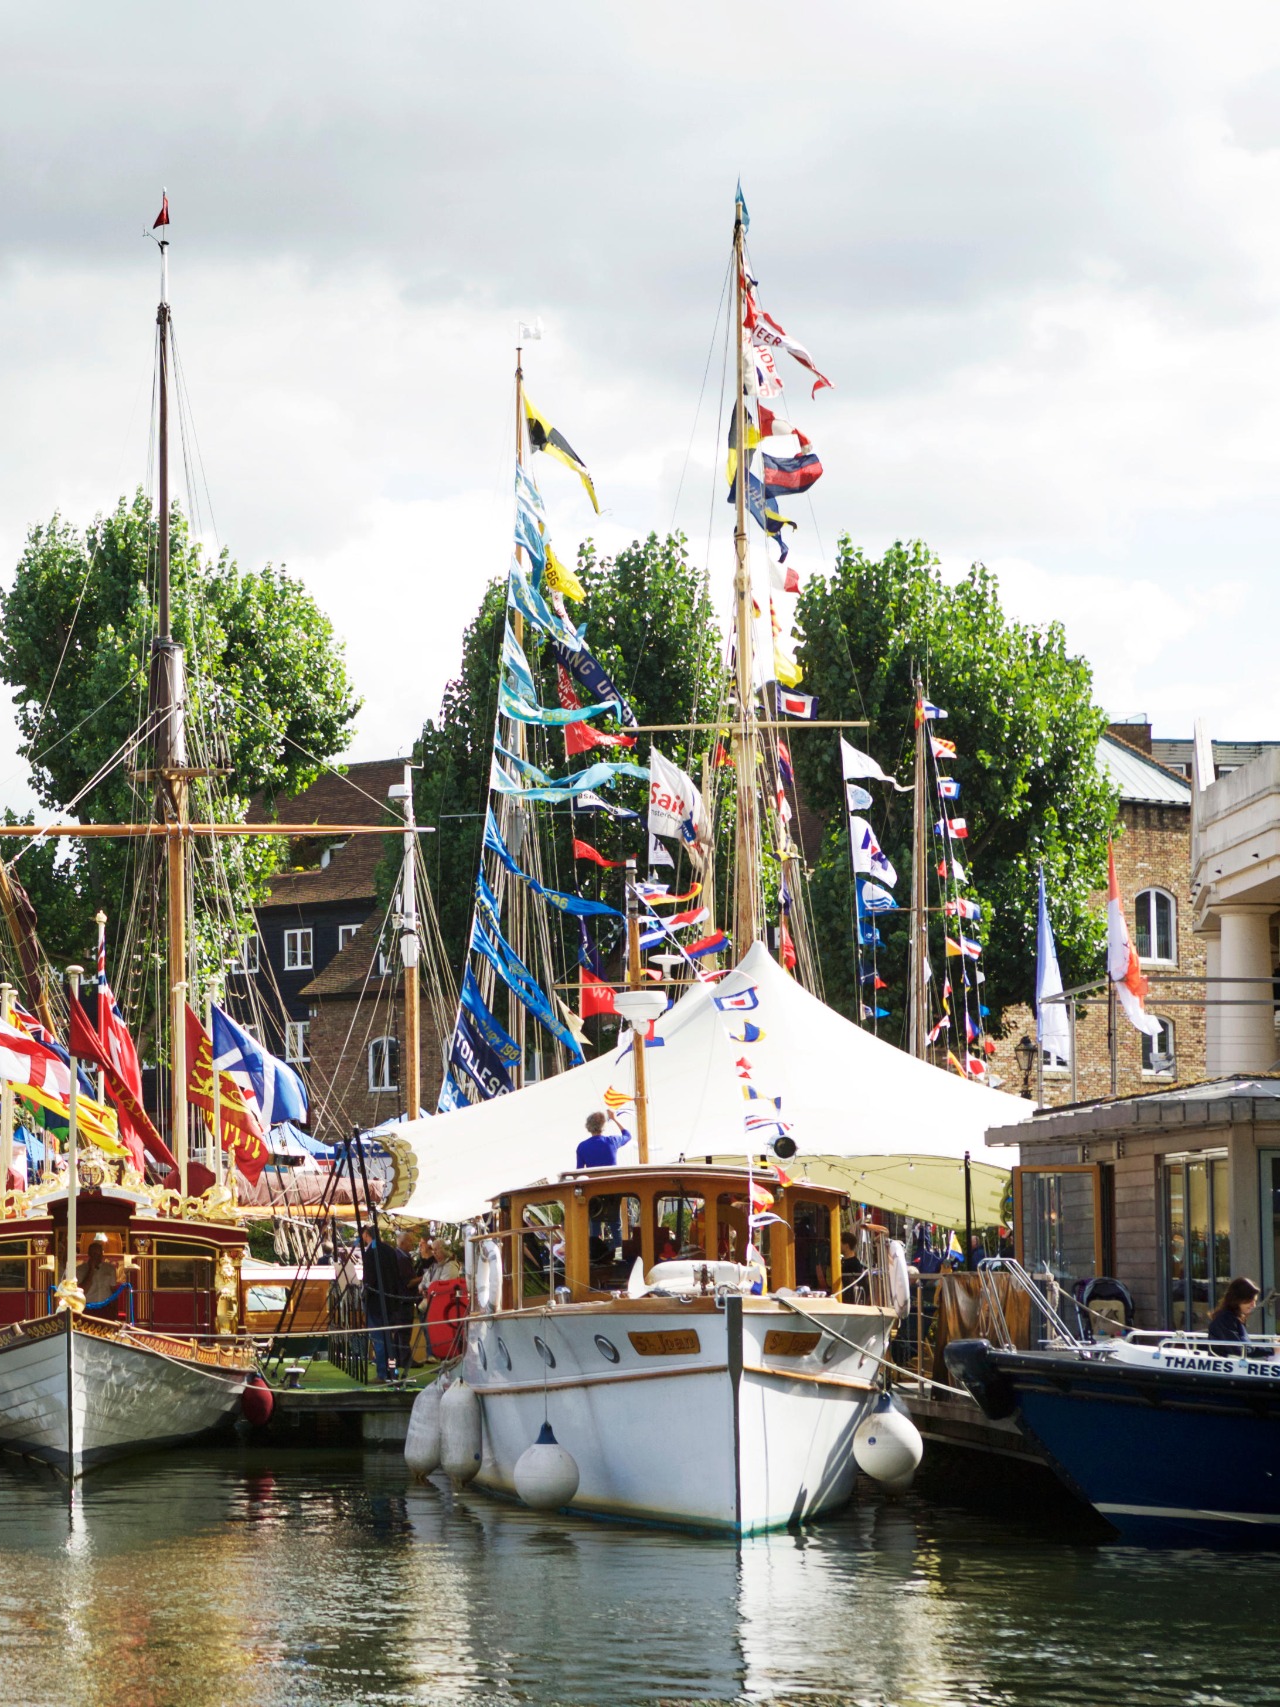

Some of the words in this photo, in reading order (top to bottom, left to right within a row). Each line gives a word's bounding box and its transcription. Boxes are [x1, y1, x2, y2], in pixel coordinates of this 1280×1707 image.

[545, 557, 559, 587] 986
[1165, 1356, 1234, 1373] THAMES
[1247, 1363, 1280, 1377] RES
